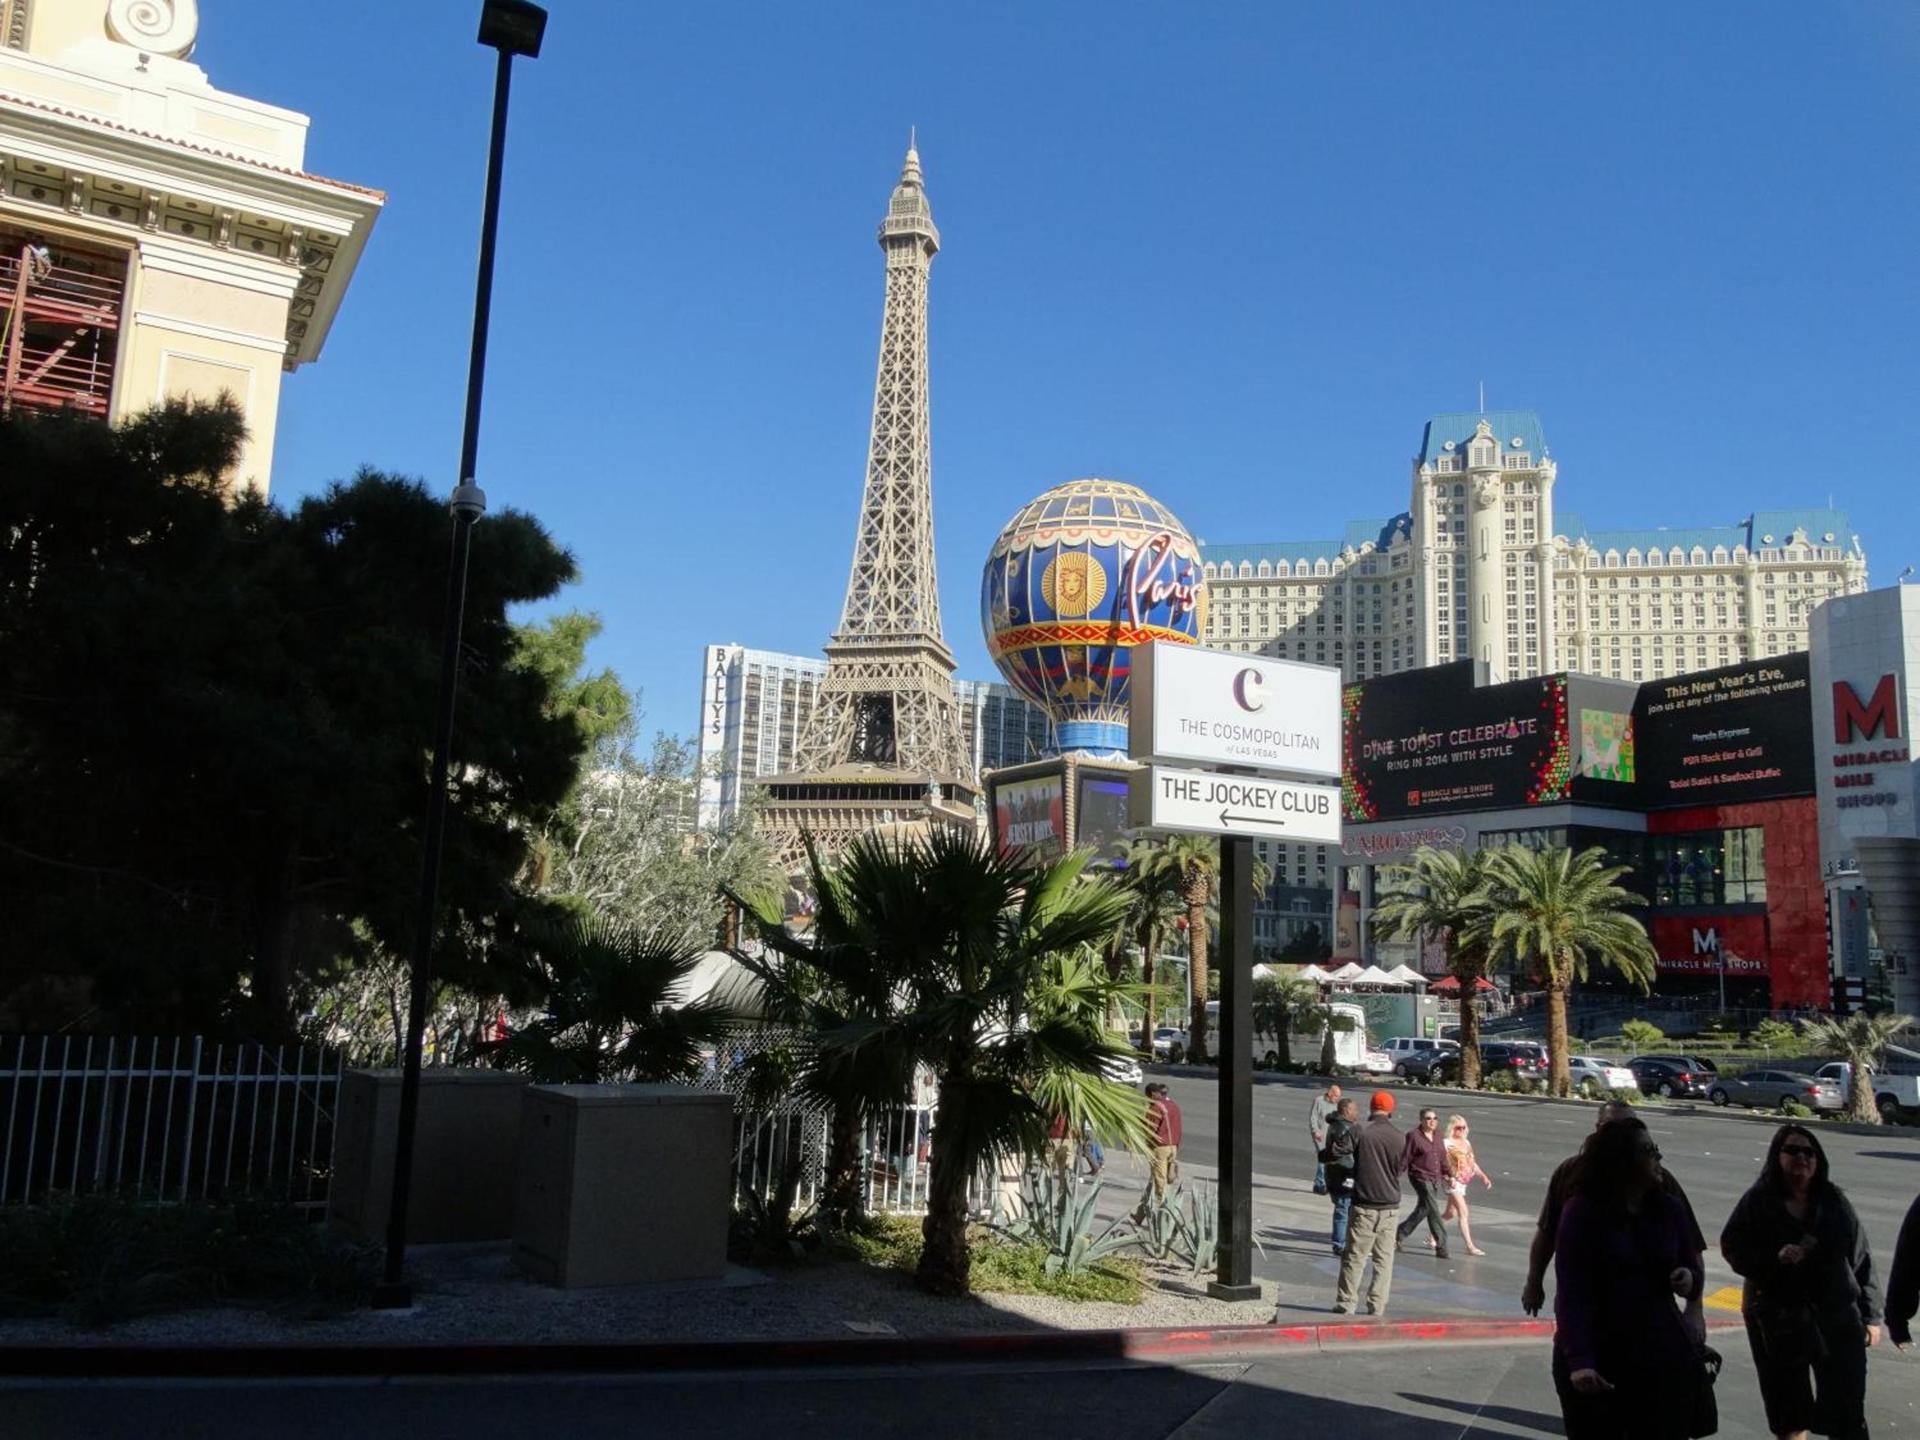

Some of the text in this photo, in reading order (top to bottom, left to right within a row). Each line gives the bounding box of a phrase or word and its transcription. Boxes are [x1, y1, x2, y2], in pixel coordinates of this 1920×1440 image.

[1128, 531, 1203, 630] Paris
[1665, 685, 1689, 699] This
[1691, 680, 1716, 694] New
[1718, 672, 1755, 689] Year's
[1714, 691, 1728, 701] the
[1730, 685, 1770, 699] following
[1772, 679, 1806, 692] venues
[1832, 673, 1899, 745] M
[1179, 718, 1320, 750] THE COSMOPOLITAN
[1236, 745, 1250, 755] LAS
[1253, 747, 1277, 758] VEGAS
[1387, 745, 1513, 772] RING IN 2014 WITH STYLE
[1833, 748, 1909, 767] MIRACLE
[1834, 772, 1874, 788] MILE
[1161, 778, 1329, 815] THE JOCKEY CLUB
[1836, 792, 1897, 809] SHOPS
[1692, 927, 1716, 955] M
[1659, 960, 1699, 969] MIRACLE
[1728, 960, 1761, 969] SHOPS
